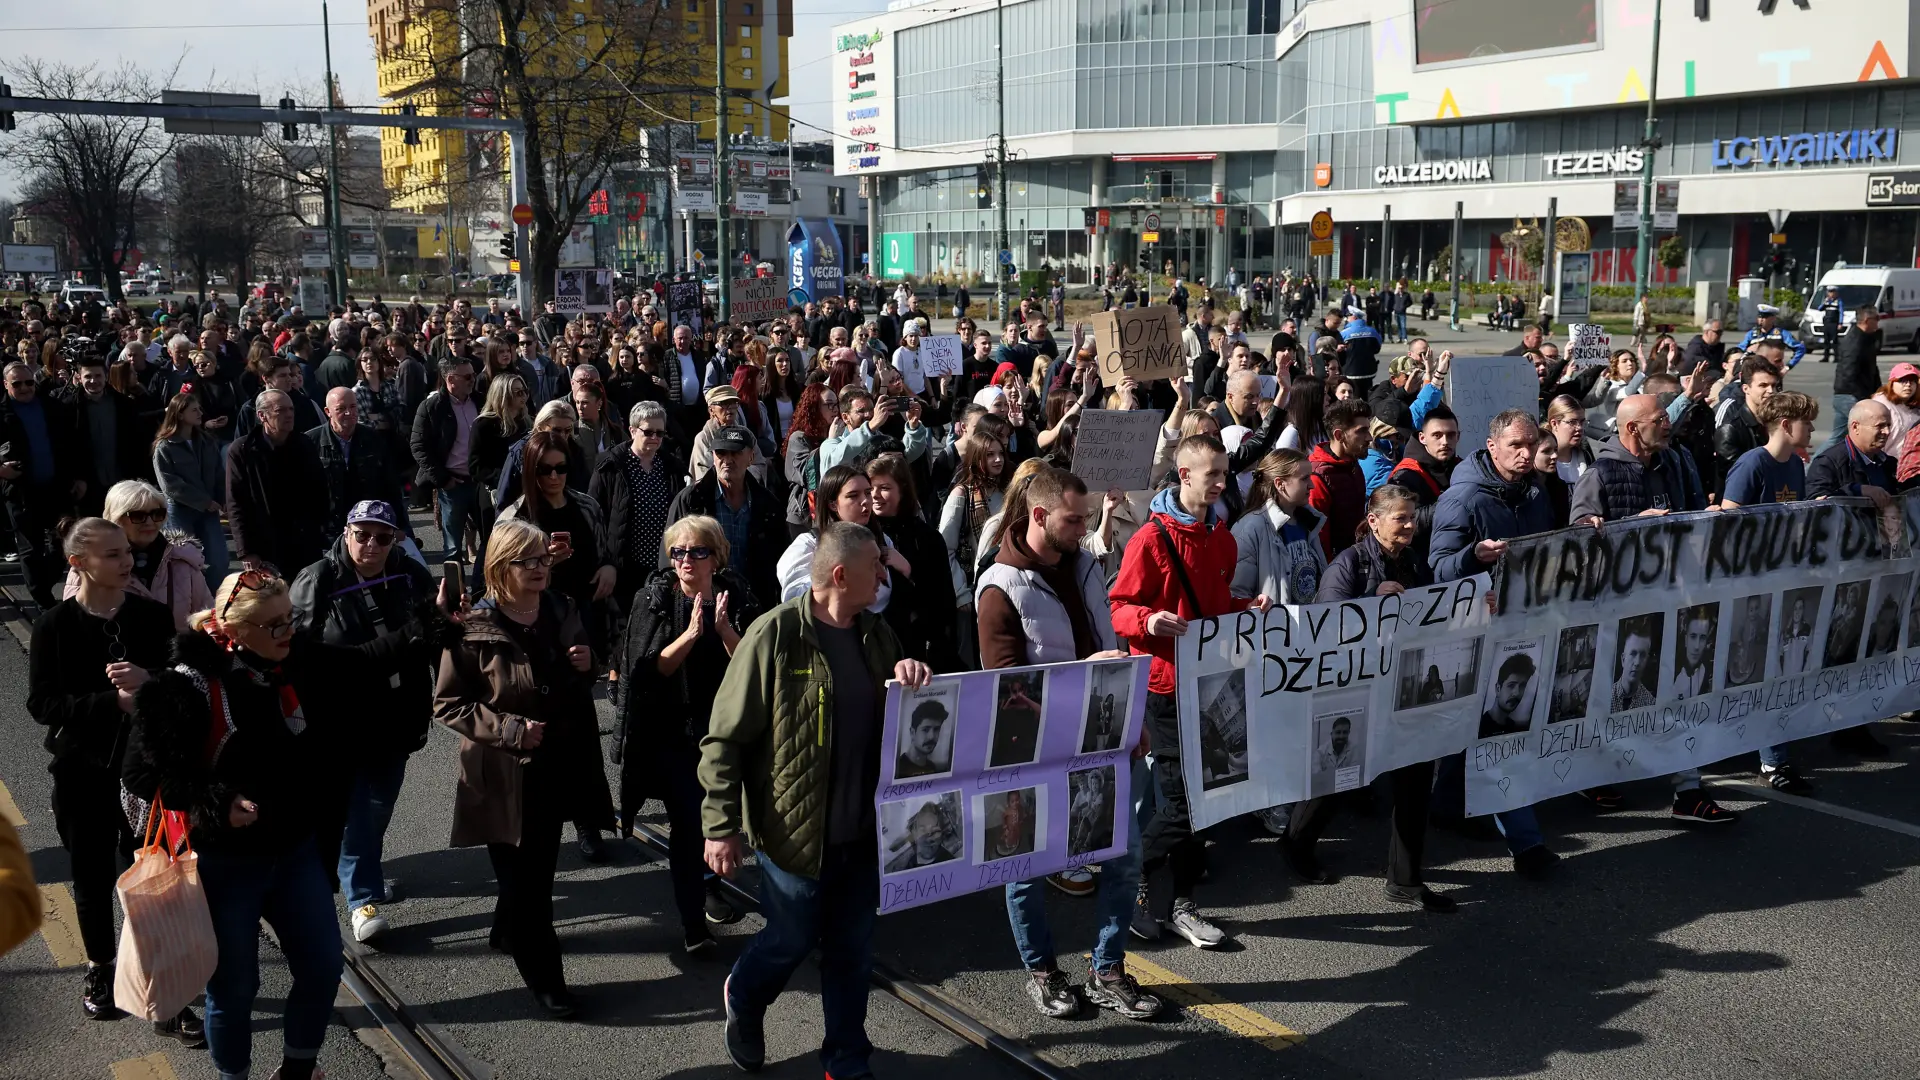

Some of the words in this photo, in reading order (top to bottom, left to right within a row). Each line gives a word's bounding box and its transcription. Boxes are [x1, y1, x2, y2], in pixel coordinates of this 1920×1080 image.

[1712, 136, 1753, 167] LC
[1374, 158, 1491, 183] CALZEDONIA
[1893, 180, 1920, 195] stor
[1148, 218, 1158, 228] 60
[810, 266, 842, 278] VEGETA
[816, 280, 837, 289] ORIGINAL
[1111, 314, 1169, 348] HOTA
[926, 358, 957, 373] SERVIS
[930, 348, 953, 359] NEMA
[1106, 342, 1183, 374] OSTAVKA
[1499, 521, 1693, 616] MLADOST
[1197, 593, 1401, 661] PRAVDA
[1419, 578, 1477, 627] ZA
[1261, 643, 1394, 698] DŽEJLU
[1475, 737, 1526, 772] ERDOAN
[1538, 718, 1601, 759] DŽEJLA
[1717, 688, 1763, 725] DŽENA
[1765, 676, 1805, 712] LEJLA
[1814, 669, 1849, 701] ESMA
[1858, 658, 1897, 691] ADEM
[882, 780, 933, 799] ERDOAN
[976, 857, 1033, 890] DŽENA
[1066, 851, 1096, 869] ESMA
[883, 871, 955, 912] DŽENAN
